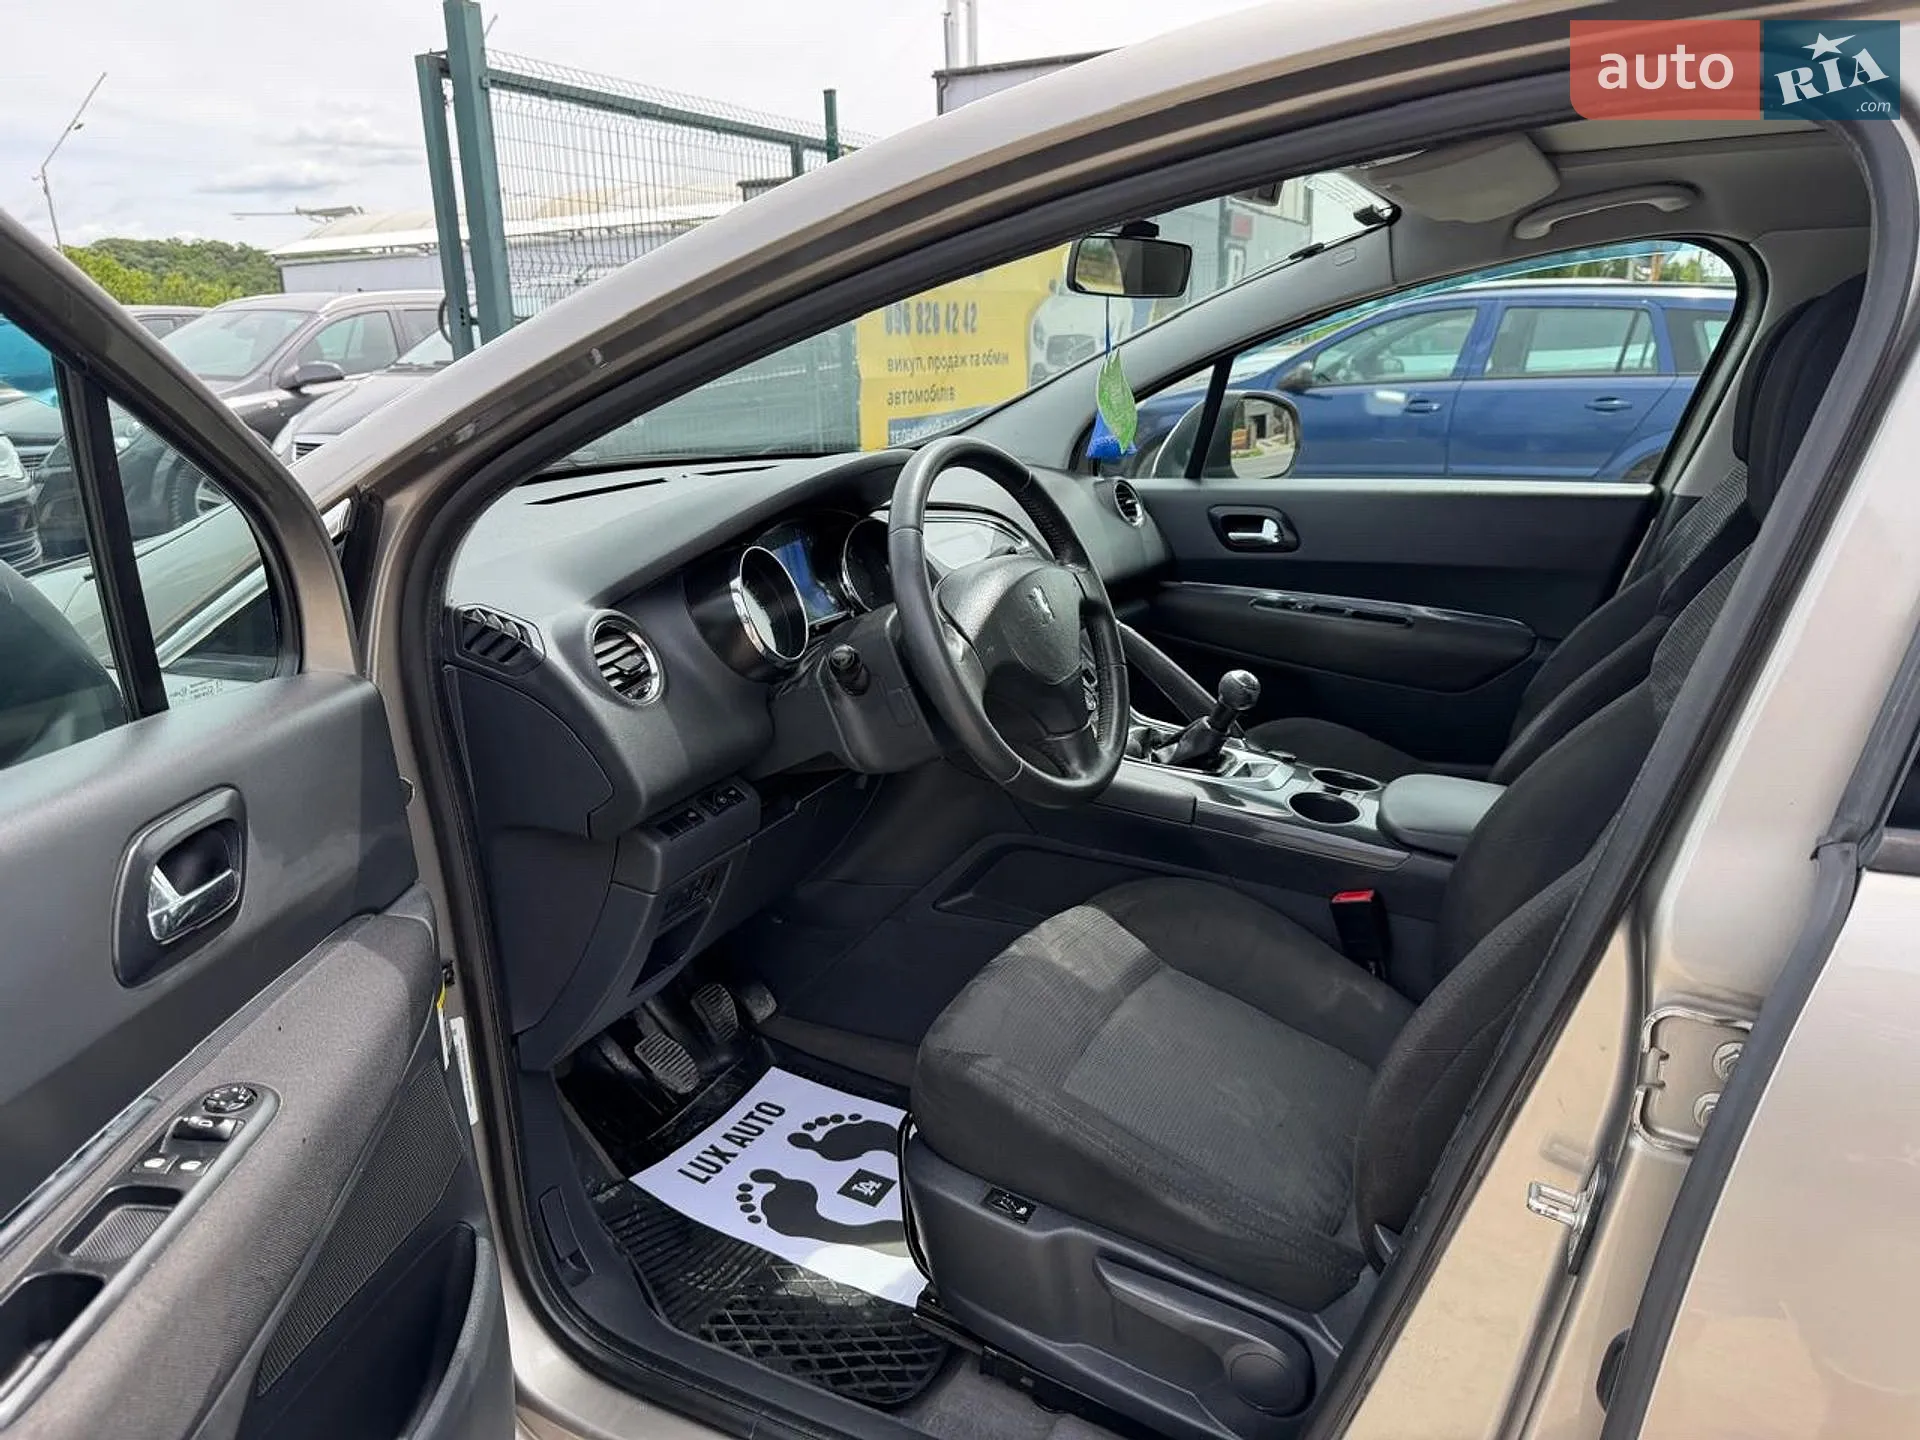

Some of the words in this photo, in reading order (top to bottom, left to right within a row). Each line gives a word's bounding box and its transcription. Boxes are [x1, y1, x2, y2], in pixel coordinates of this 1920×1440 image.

[945, 300, 959, 335] 42
[963, 299, 978, 335] 42
[927, 353, 968, 375] продаж
[982, 348, 1010, 367] обмін
[887, 384, 956, 407] автомобілів
[677, 1144, 738, 1185] LUX
[721, 1100, 786, 1150] AUTO
